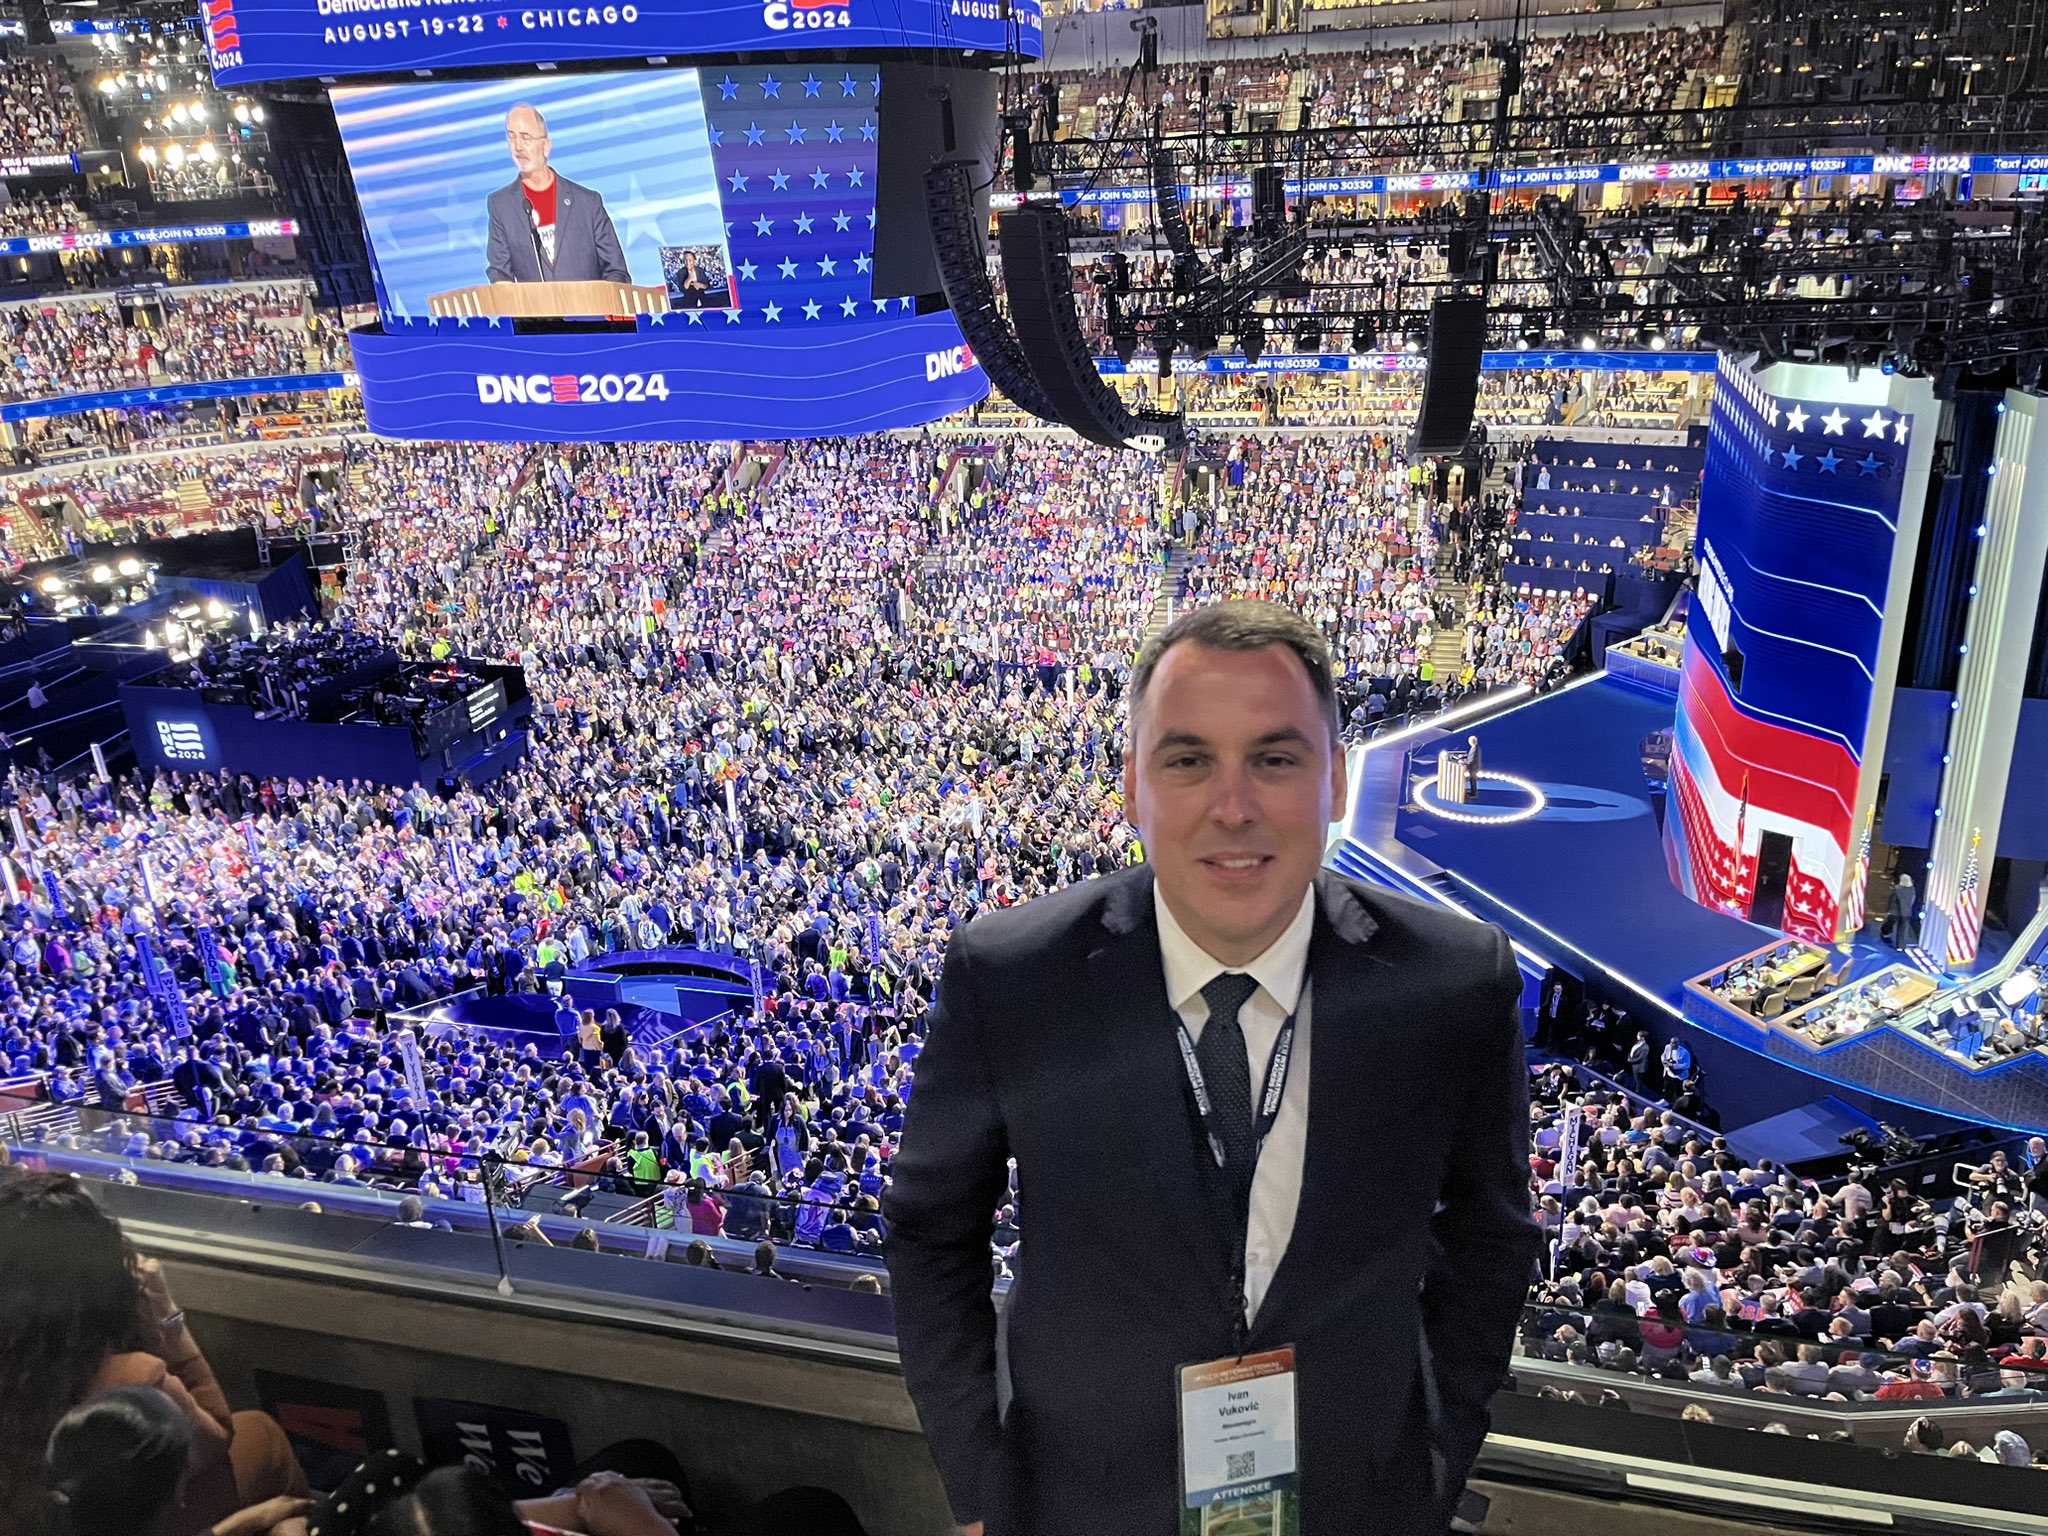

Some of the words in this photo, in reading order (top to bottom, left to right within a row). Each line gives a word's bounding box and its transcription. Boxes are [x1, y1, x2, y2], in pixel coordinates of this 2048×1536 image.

[324, 20, 409, 45] AUGUST
[420, 15, 484, 36] 19-22
[521, 5, 638, 29] CHICAGO
[792, 10, 851, 29] 2024
[217, 51, 243, 68] 2024
[1302, 182, 1327, 193] JOIN
[1329, 181, 1339, 191] to
[1341, 180, 1373, 191] 30330
[1388, 177, 1420, 191] DNC
[1432, 174, 1469, 189] 2024
[1523, 171, 1550, 182] JOIN
[1552, 170, 1562, 181] to
[1619, 167, 1656, 181] DNC
[1668, 163, 1710, 178] 2024
[1764, 161, 1792, 172] JOIN
[1873, 156, 1912, 172] DNC
[1928, 155, 1971, 172] 2024
[1994, 158, 2020, 169] Text
[1098, 189, 1119, 200] JOIN
[1133, 189, 1157, 200] 3033
[29, 237, 62, 251] DNC
[75, 231, 112, 248] 2024
[156, 228, 181, 240] JOIN
[183, 229, 193, 239] to
[194, 225, 226, 237] 30330
[249, 221, 280, 237] DNC
[925, 345, 962, 382] DNC
[1223, 359, 1245, 370] Text
[1286, 357, 1320, 369] 30330
[1349, 356, 1383, 370] DNC
[476, 374, 551, 404] DNC
[578, 373, 670, 403] 2024
[177, 750, 206, 760] 2024
[202, 932, 219, 975] NEVADA
[163, 979, 185, 1028] WYOMING
[1262, 1087, 1275, 1116] FORUM
[1565, 1116, 1578, 1175] MICHIGAN
[1227, 1390, 1249, 1401] Ivan
[505, 1429, 551, 1486] We
[1212, 1480, 1272, 1501] ATTENDEE
